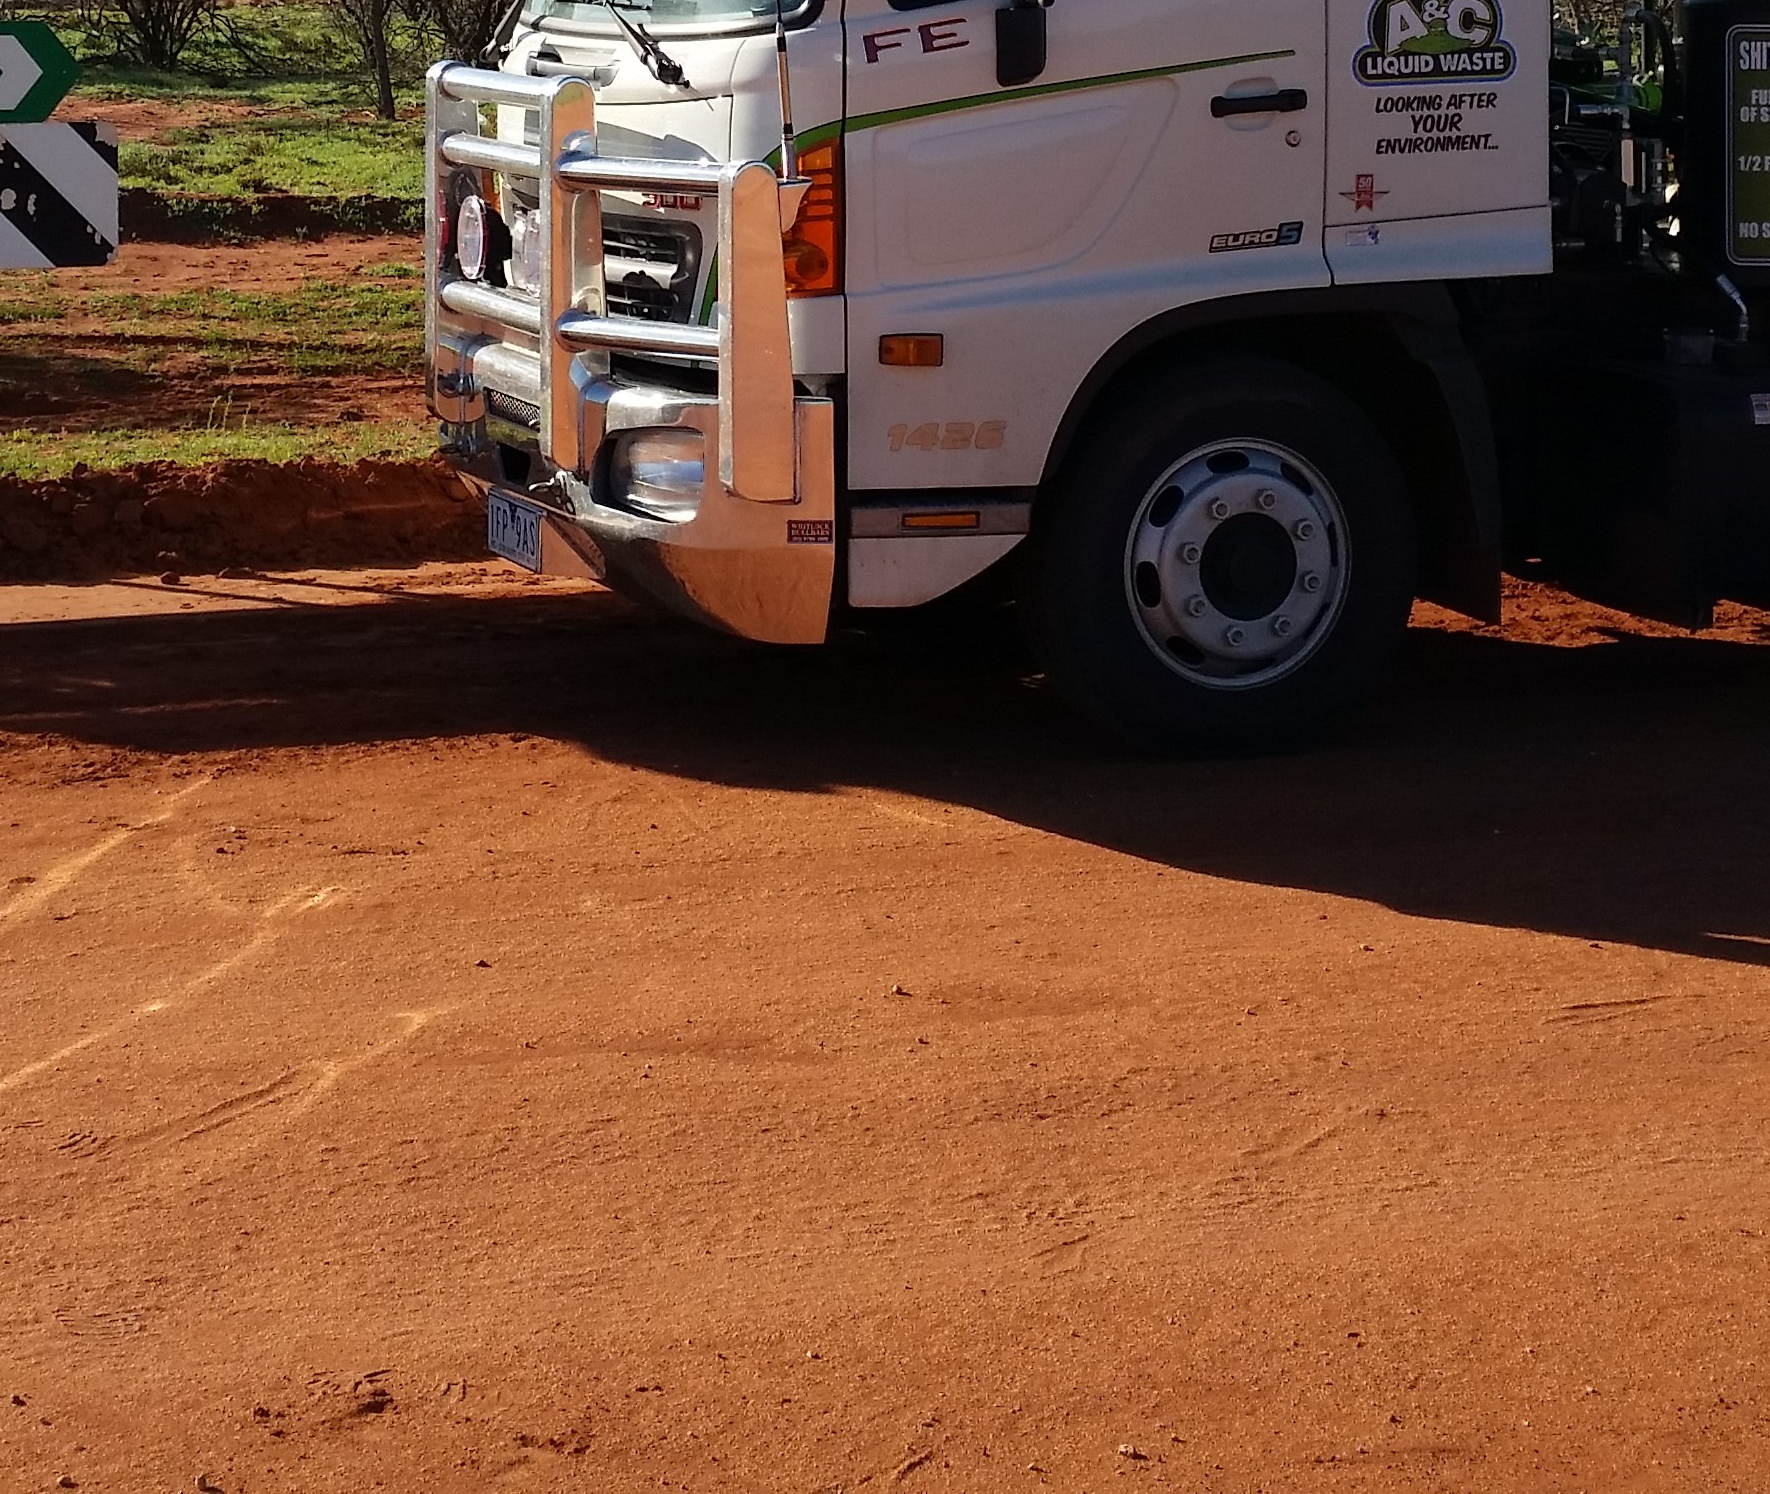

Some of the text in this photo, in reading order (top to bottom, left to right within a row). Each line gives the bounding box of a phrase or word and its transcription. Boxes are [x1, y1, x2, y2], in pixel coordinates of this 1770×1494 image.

[862, 18, 969, 64] FE
[1366, 52, 1505, 76] LIQUID WASTE
[1375, 92, 1498, 114] LOOKING AFTER
[1410, 113, 1463, 134] YOUR
[1740, 106, 1759, 123] OF
[1375, 133, 1499, 155] ENVIRONMENT...
[1738, 156, 1762, 172] 1/2
[1739, 222, 1759, 239] NO
[887, 420, 1007, 452] 1426
